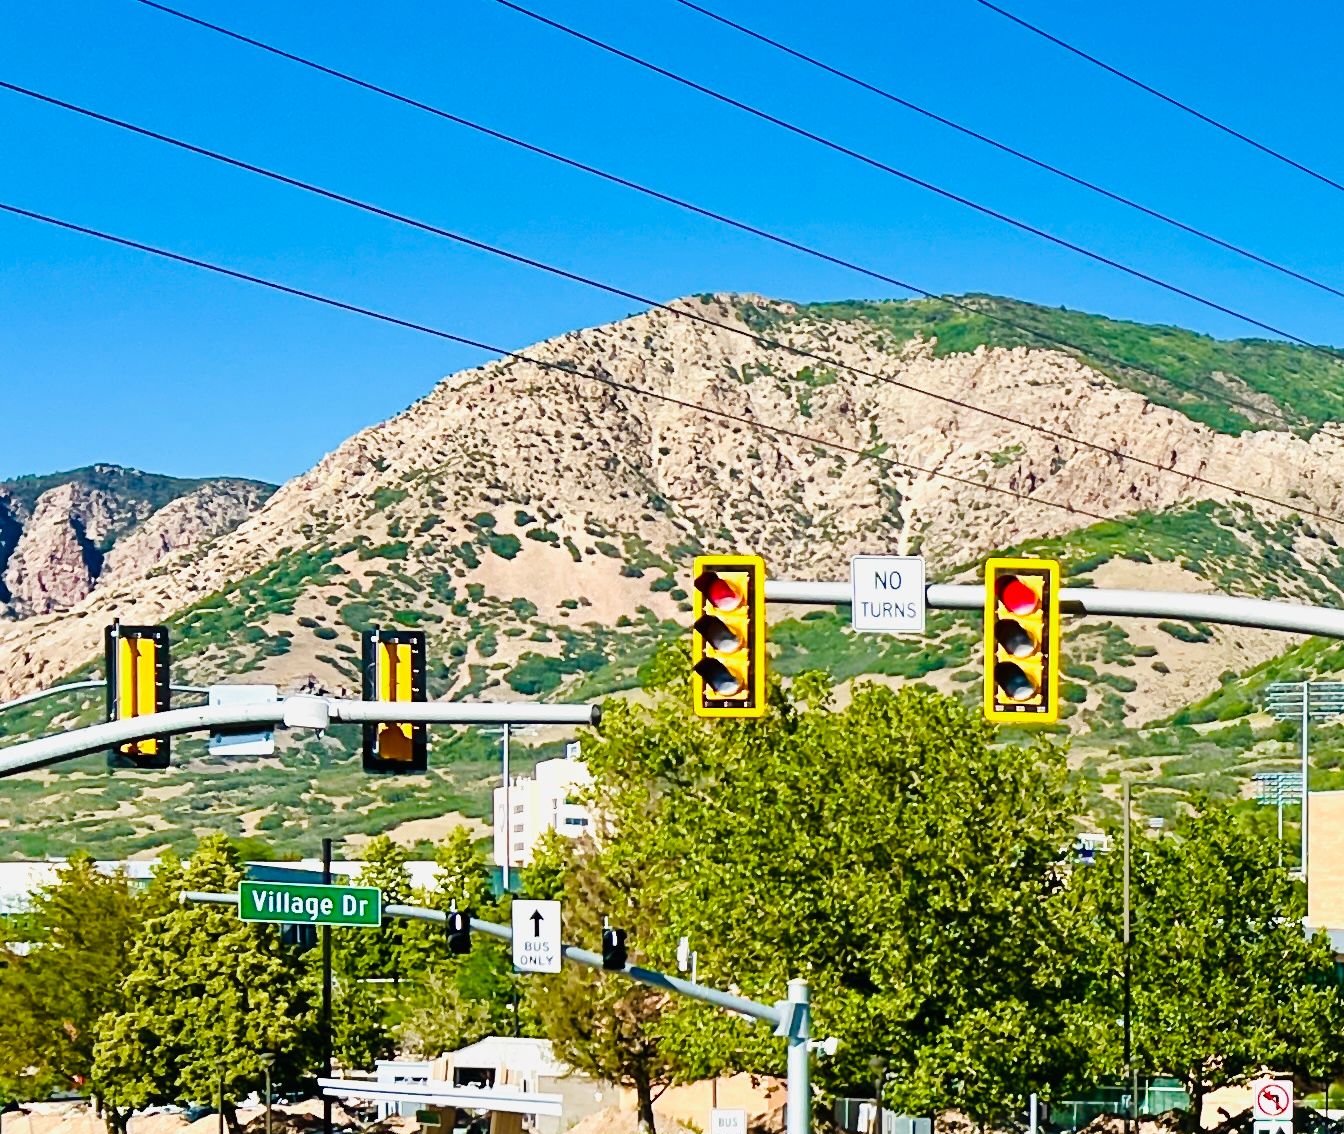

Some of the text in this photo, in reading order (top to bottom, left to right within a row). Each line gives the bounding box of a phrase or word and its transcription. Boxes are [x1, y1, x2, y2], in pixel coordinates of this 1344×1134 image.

[874, 570, 902, 590] NO
[861, 601, 917, 618] TURNS
[251, 889, 369, 921] Village Dr
[524, 941, 550, 951] BUS
[520, 955, 554, 966] ONLY
[718, 1118, 738, 1127] BUS
